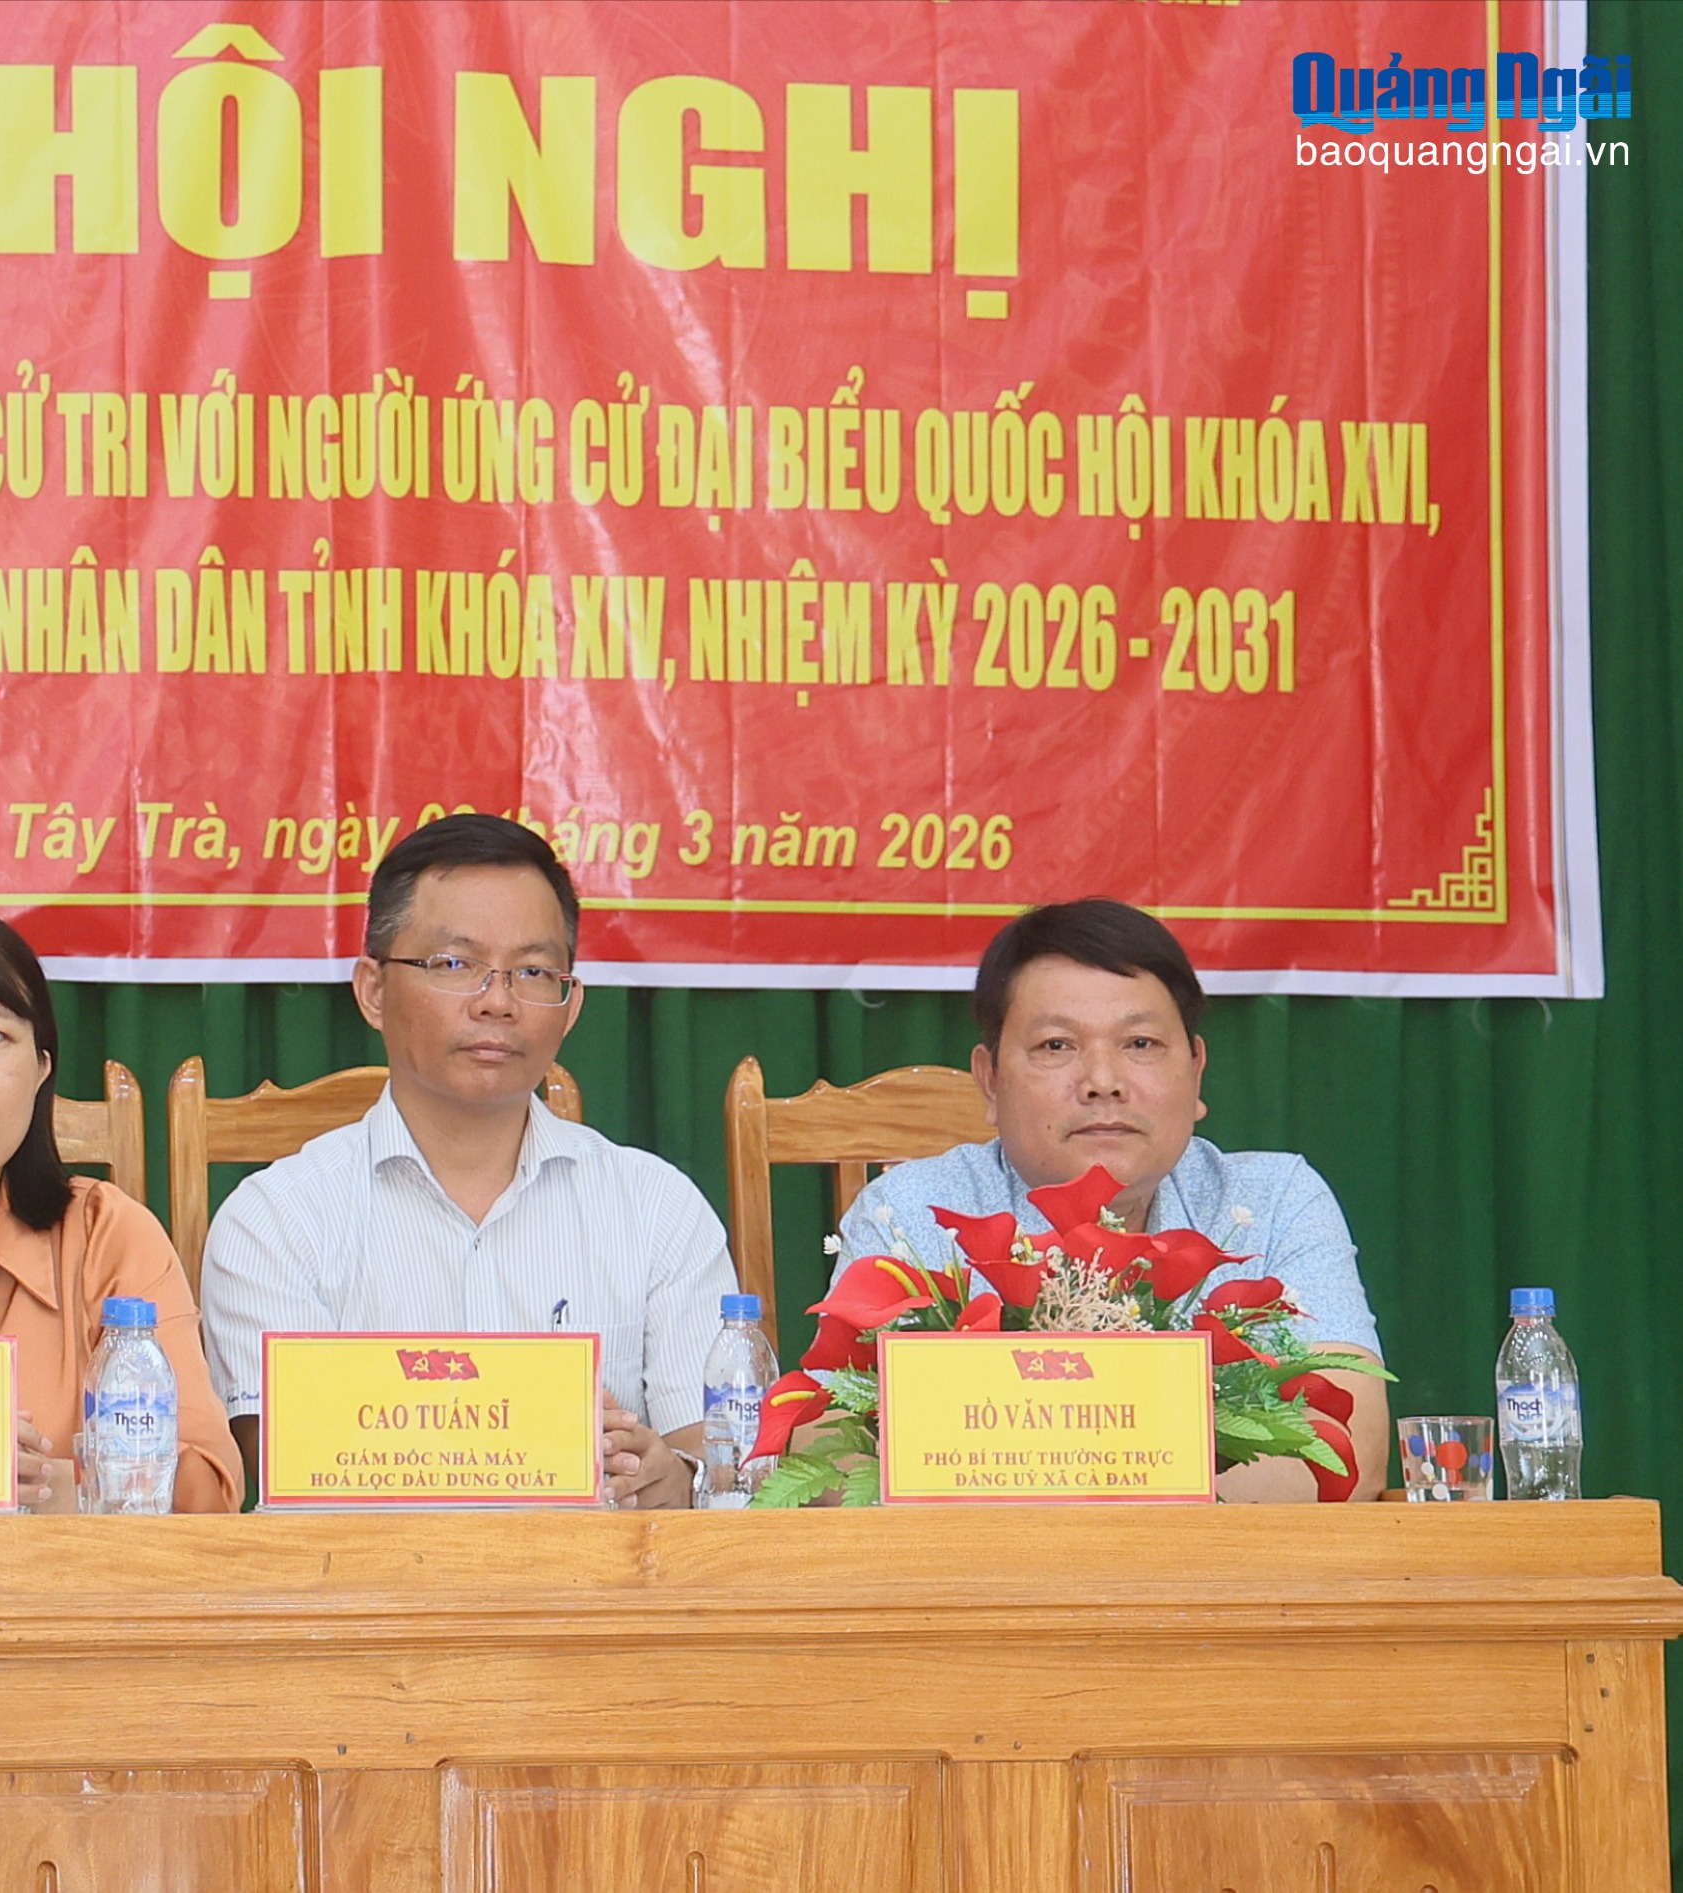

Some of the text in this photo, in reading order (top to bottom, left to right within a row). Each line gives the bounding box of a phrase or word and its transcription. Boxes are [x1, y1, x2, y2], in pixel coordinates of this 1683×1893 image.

[453, 71, 1018, 319] NGHỊ
[56, 392, 147, 497] TRI
[161, 368, 254, 498] VỚI
[268, 368, 429, 500] NGƯỜI
[442, 373, 555, 504] ỨNG
[570, 371, 649, 506] CỬ
[656, 404, 752, 531] ĐẠI
[768, 365, 901, 513] BIỂU
[914, 381, 1064, 525] QUỐC
[1077, 393, 1171, 540] HỘI
[1185, 394, 1331, 522] KHÓA
[1340, 420, 1440, 537] XVI,
[155, 545, 267, 674] DÂN
[278, 538, 402, 674] TỈNH
[416, 549, 557, 679] KHÓA
[571, 574, 676, 694] XIV,
[689, 558, 871, 707] NHIỆM
[886, 557, 959, 686] KỲ
[972, 582, 1117, 690] 2026
[1129, 637, 1150, 658] -
[1161, 587, 1295, 694] 2031
[9, 802, 117, 875] Tây
[137, 802, 242, 870] Trà,
[262, 802, 400, 876] ngày
[679, 808, 714, 866] 3
[731, 811, 858, 867] năm
[877, 811, 1014, 871] 2026
[358, 1404, 409, 1430] CAO
[488, 1399, 510, 1430] SĨ
[1004, 1398, 1053, 1430] VĂN
[1060, 1404, 1137, 1435] THỊNH
[336, 1449, 387, 1466] GIÁM
[439, 1448, 478, 1466] NHÀ
[484, 1448, 528, 1466] MÁY
[923, 1448, 1174, 1468] PHÓ BÍ THƯ THƯỜNG TRỰC
[311, 1470, 351, 1487] HOÁ
[357, 1472, 396, 1490] LỌC
[446, 1472, 500, 1486] DUNG
[955, 1469, 1007, 1486] ĐẢNG
[1043, 1469, 1068, 1486] XÃ
[1075, 1469, 1100, 1486] CÀ
[1106, 1472, 1148, 1486] ĐAM
